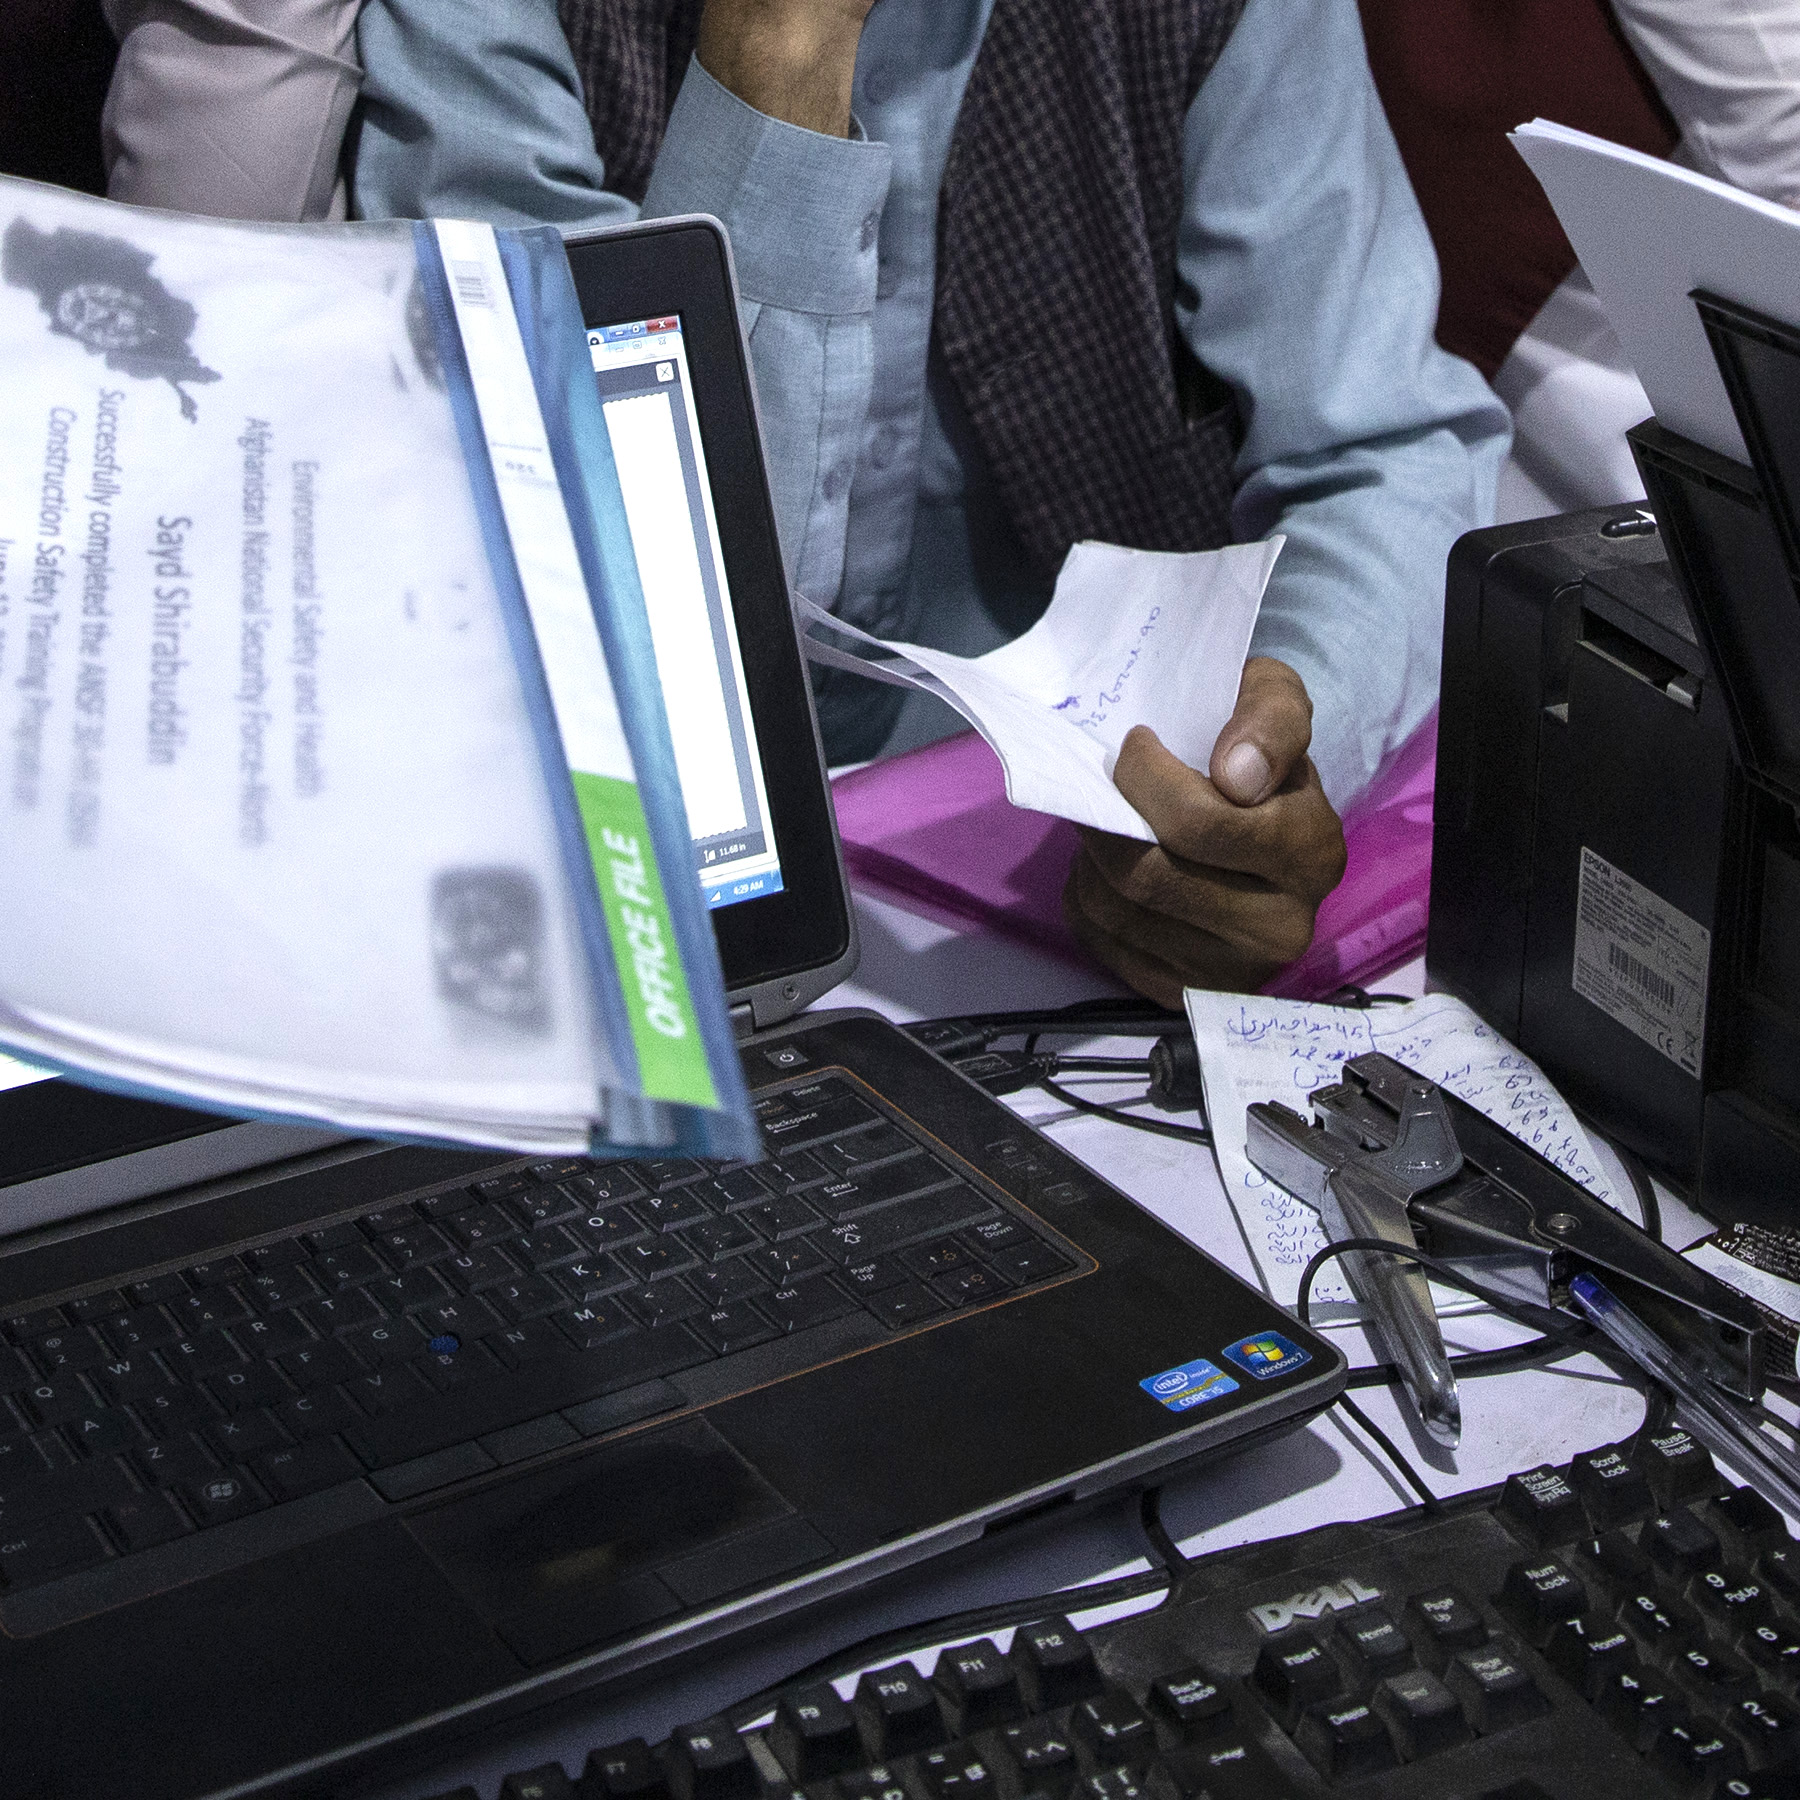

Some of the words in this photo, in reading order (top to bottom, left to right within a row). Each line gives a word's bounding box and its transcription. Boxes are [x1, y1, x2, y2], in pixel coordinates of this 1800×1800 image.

[85, 388, 126, 505] Successfully
[39, 407, 77, 537] Construction
[237, 416, 274, 525] Afghanistan
[291, 461, 323, 599] Environmental
[147, 516, 193, 578] Sayd
[80, 511, 121, 616] completed
[26, 542, 65, 606] Safety
[241, 531, 273, 614] National
[80, 622, 112, 656] the
[288, 604, 324, 668] Safety
[15, 612, 61, 691] Training
[235, 618, 273, 704] Security
[148, 586, 192, 765] Shirabuddin
[294, 673, 322, 714] and
[294, 722, 326, 799] Health
[602, 828, 652, 907] FILE
[1584, 852, 1610, 876] EPSON
[750, 880, 763, 891] AM
[622, 907, 686, 1039] OFFICE
[792, 1084, 822, 1097] Delete
[765, 1111, 819, 1131] Backspace
[823, 1182, 852, 1194] Enter
[650, 1197, 662, 1208] P
[832, 1223, 859, 1235] Shift
[976, 1221, 1002, 1233] Page
[984, 1226, 1013, 1239] Down
[572, 1265, 589, 1277] K
[850, 1263, 878, 1275] Page
[858, 1273, 875, 1282] Up
[776, 1288, 798, 1301] Ctrl
[574, 1308, 595, 1322] M
[710, 1311, 729, 1323] Alt
[251, 1321, 268, 1333] R
[180, 1342, 196, 1355] E
[108, 1360, 132, 1376] W
[1257, 1357, 1296, 1376] Windows
[1296, 1352, 1304, 1362] 7
[1156, 1374, 1184, 1391] intel
[34, 1385, 55, 1398] Q
[1179, 1390, 1209, 1407] CORE
[1211, 1386, 1224, 1397] i5
[1651, 1432, 1686, 1447] Pause
[1661, 1444, 1694, 1458] Break
[1589, 1452, 1622, 1469] Scroll
[1517, 1471, 1546, 1485] Print
[1599, 1465, 1630, 1478] Lock
[1525, 1475, 1561, 1492] Screen
[1534, 1485, 1572, 1503] SysRq
[1, 1540, 29, 1554] Ctrl
[1524, 1564, 1558, 1580] Num
[1535, 1574, 1570, 1591] Lock
[1705, 1573, 1726, 1588] 9
[1723, 1585, 1760, 1604] PgUp
[1249, 1578, 1381, 1632] DELL
[1423, 1597, 1455, 1612] Page
[1636, 1596, 1656, 1612] 8
[1432, 1613, 1452, 1623] Up
[1035, 1634, 1064, 1649] F12
[1356, 1624, 1394, 1642] Home
[1565, 1619, 1585, 1635] 7
[1588, 1633, 1627, 1651] Home
[1756, 1626, 1778, 1641] 6
[1282, 1646, 1322, 1667] Insert
[1687, 1650, 1710, 1667] 5
[958, 1659, 986, 1673] F11
[879, 1681, 908, 1697] F10
[1168, 1679, 1204, 1696] Back
[1621, 1674, 1639, 1689] 4
[1177, 1685, 1217, 1704] space
[798, 1706, 822, 1721] F9
[1327, 1705, 1370, 1726] Delete
[1742, 1701, 1766, 1716] 2
[1694, 1740, 1724, 1756] End
[1728, 1779, 1751, 1796] 0
